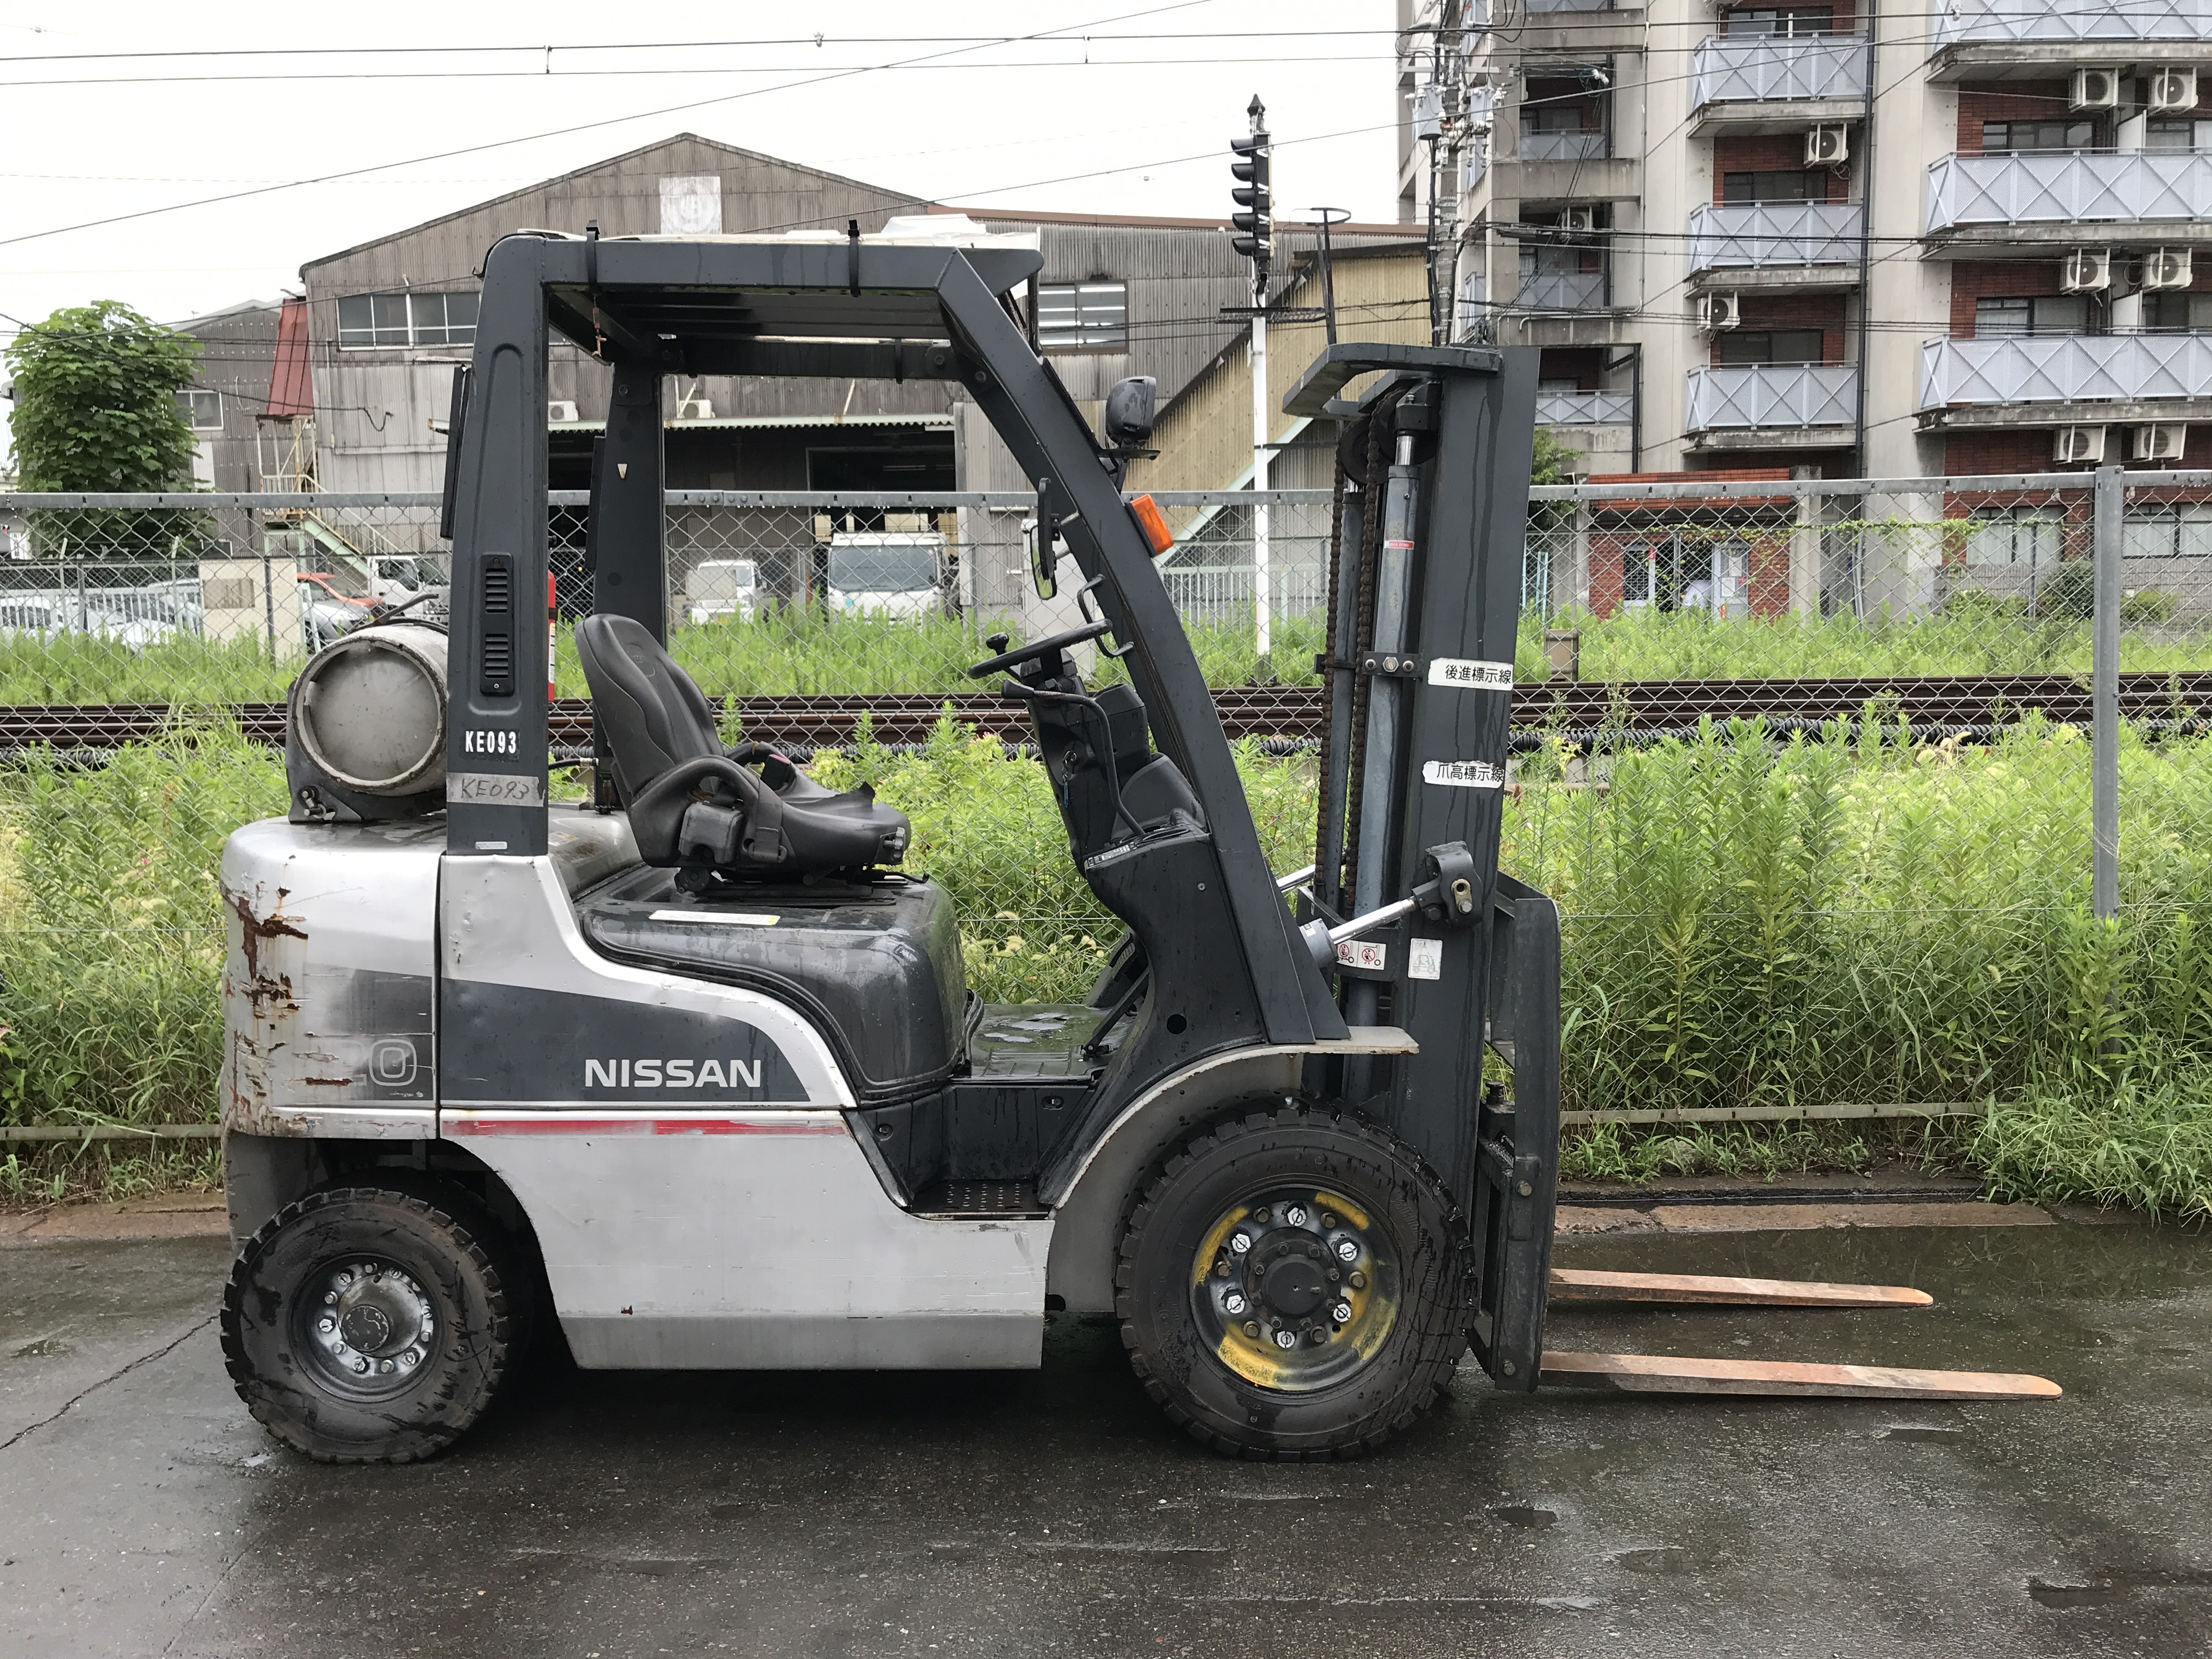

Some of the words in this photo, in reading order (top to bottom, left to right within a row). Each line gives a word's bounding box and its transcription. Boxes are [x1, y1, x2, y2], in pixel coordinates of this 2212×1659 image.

[1445, 664, 1511, 684] 後進標示線
[466, 731, 516, 753] KE093
[1437, 764, 1503, 782] 爪高標示線
[461, 778, 529, 799] KE093
[585, 1059, 761, 1087] NISSAN
